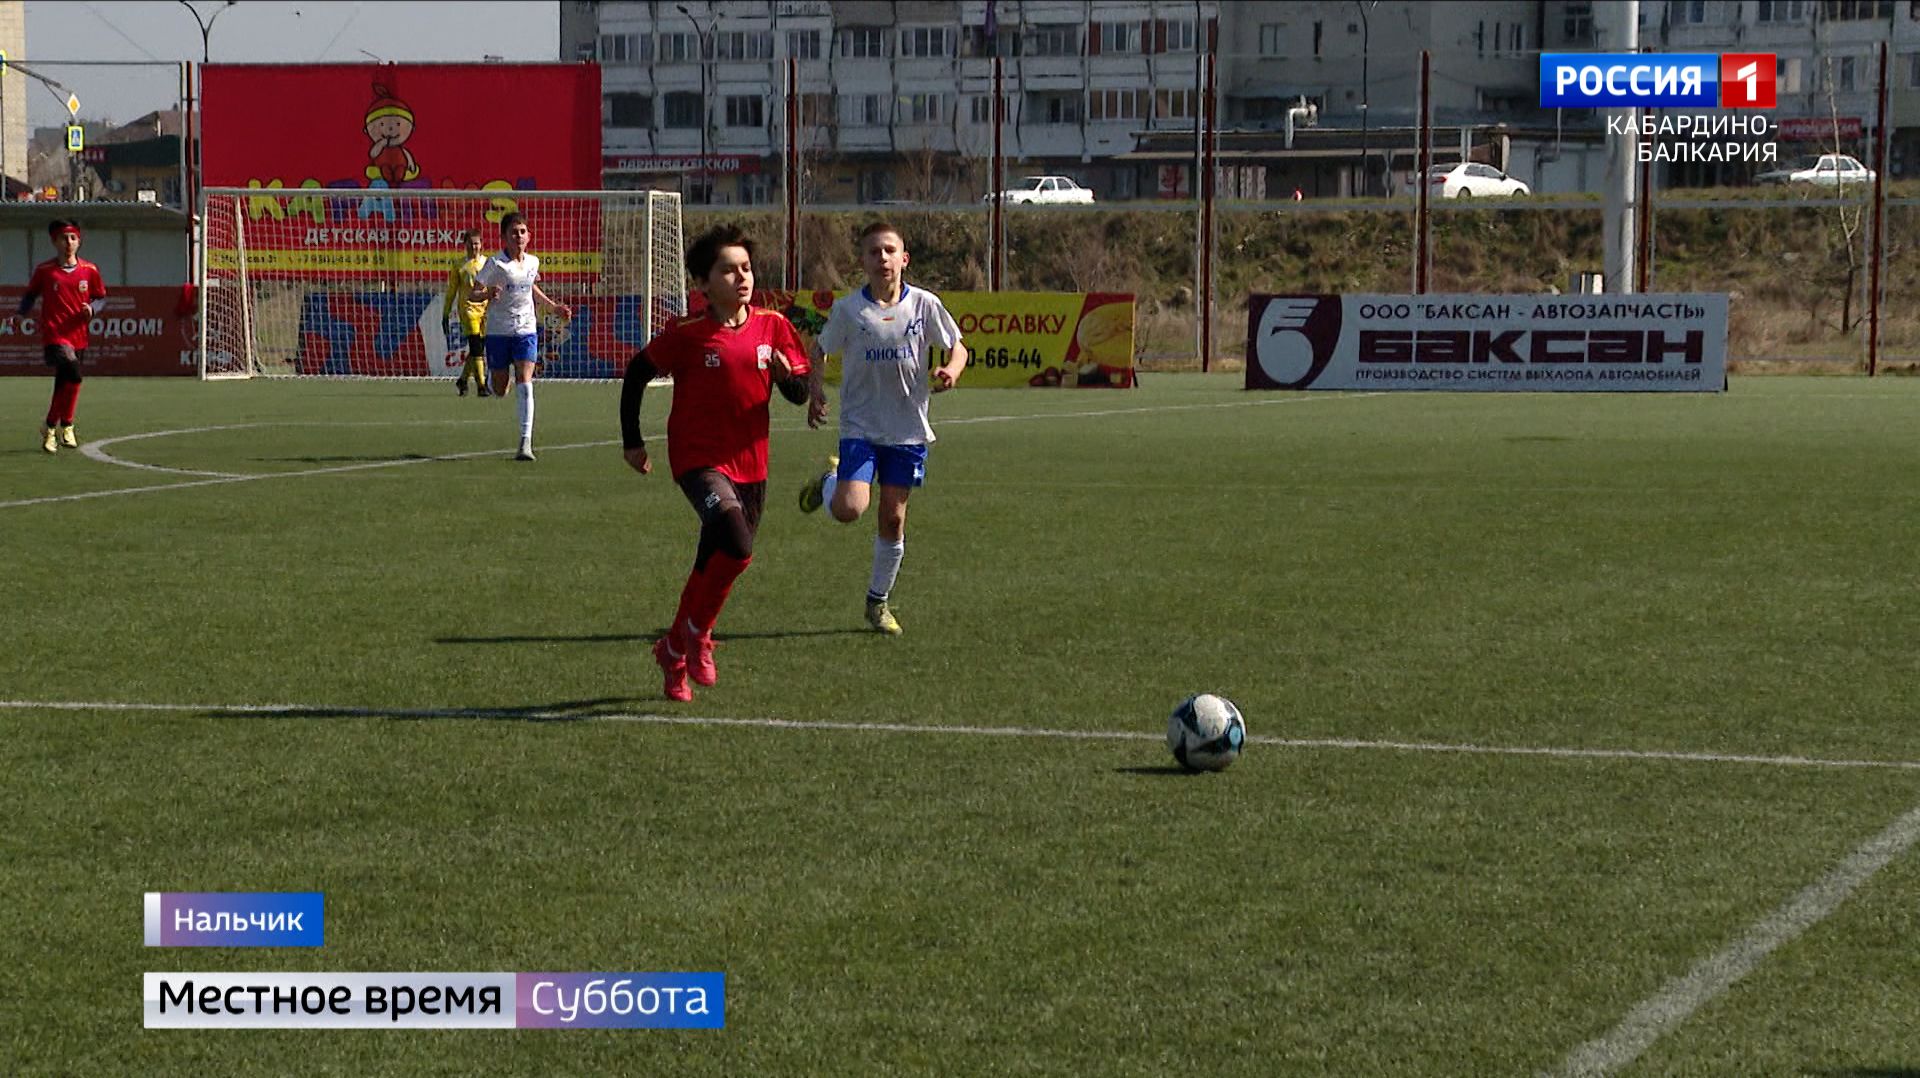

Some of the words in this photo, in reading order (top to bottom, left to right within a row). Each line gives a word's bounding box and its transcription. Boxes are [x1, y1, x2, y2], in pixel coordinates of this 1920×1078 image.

[304, 228, 390, 245] ДЕТСКАЯ
[397, 229, 466, 245] ОДЕЖД
[1359, 304, 1411, 320] ООО
[88, 318, 164, 339] ОДОМ!
[958, 313, 1067, 336] ОСТАВКУ
[704, 352, 721, 368] 25
[1355, 369, 1464, 381] ПРОИЗВОДСТВО
